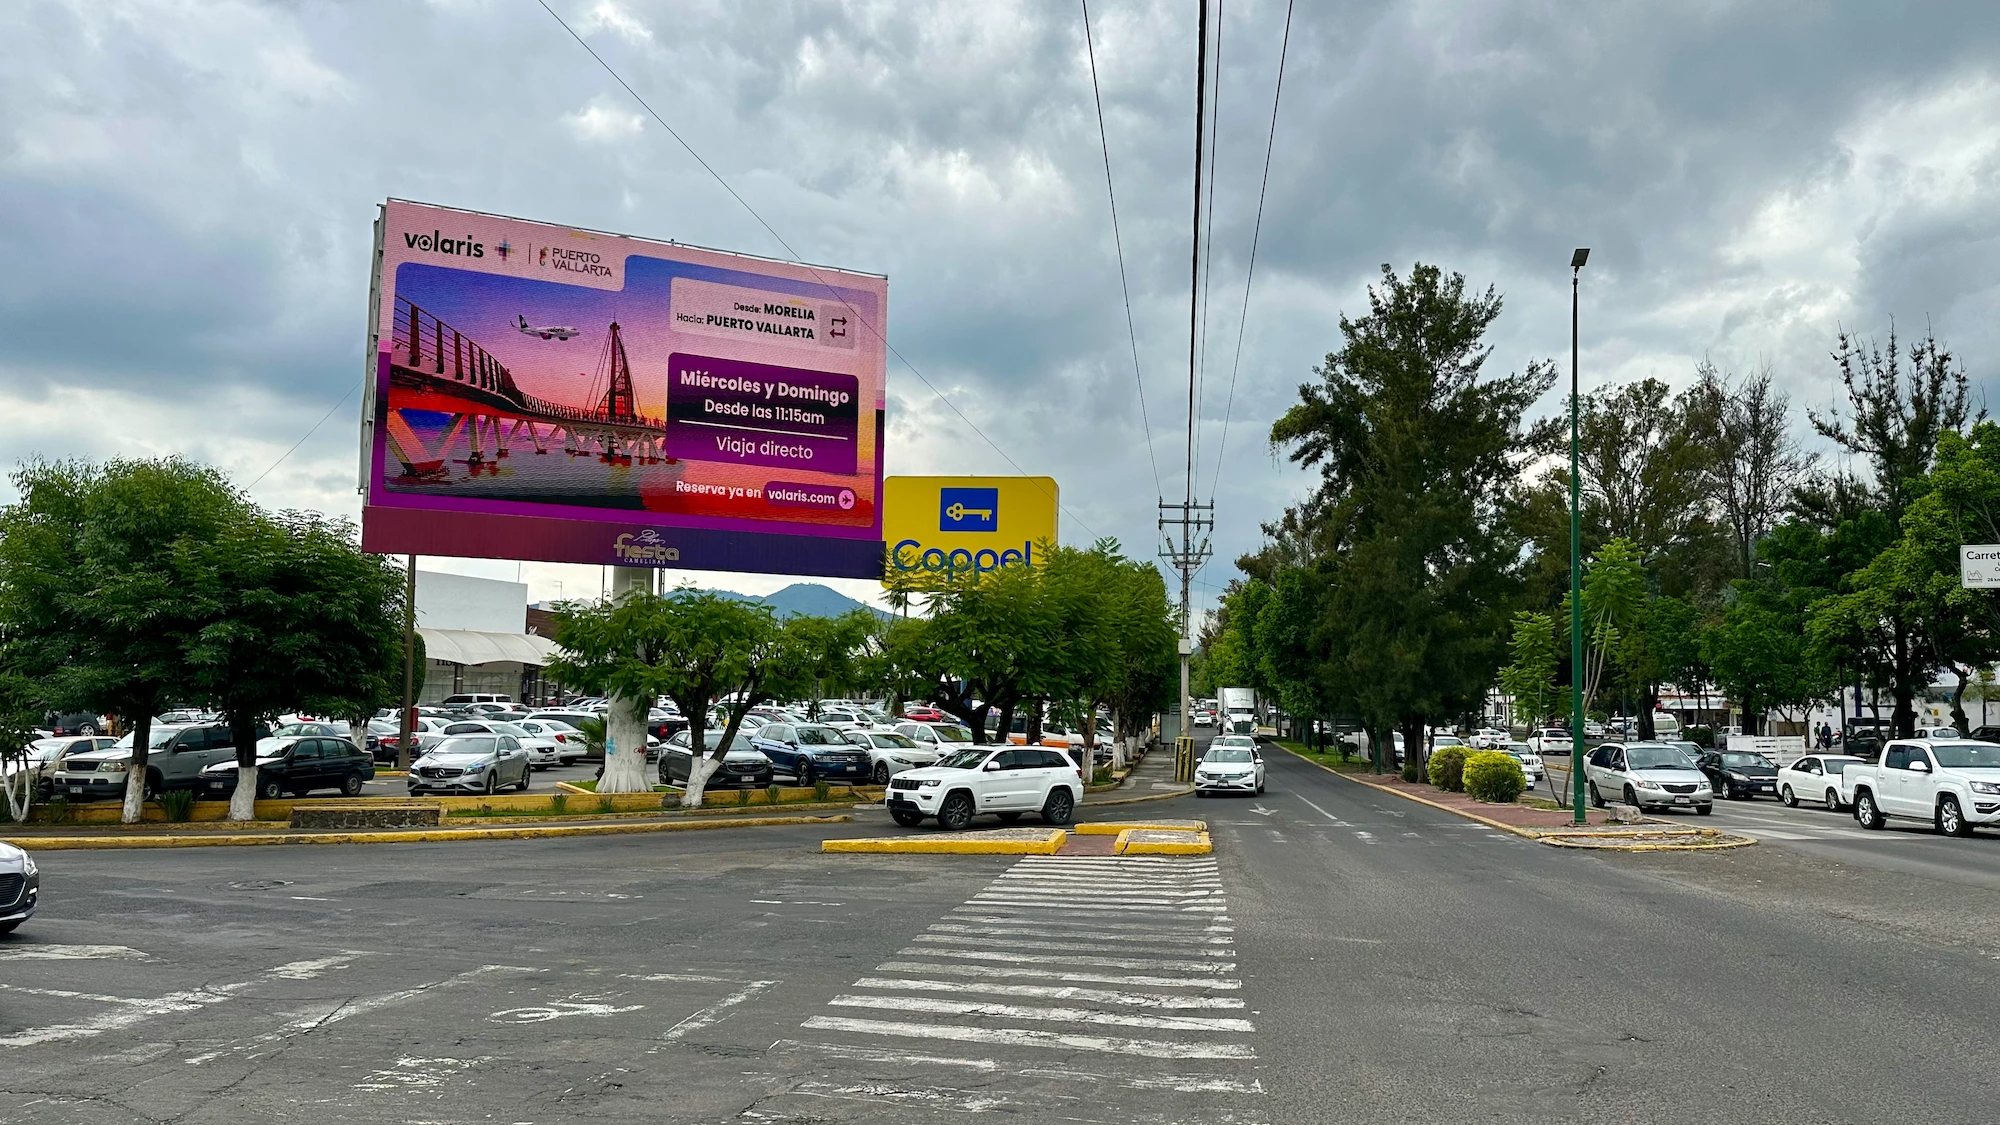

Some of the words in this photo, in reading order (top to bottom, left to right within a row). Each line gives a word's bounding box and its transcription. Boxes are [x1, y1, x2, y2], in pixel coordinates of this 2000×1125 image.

[404, 230, 484, 258] volaris
[552, 248, 601, 264] PUERTO
[552, 258, 613, 277] VALLARTA
[733, 302, 762, 314] Desde:
[764, 303, 816, 321] MORELIA
[676, 312, 704, 325] Hacia:
[706, 314, 754, 332] PUERTO
[756, 321, 815, 340] VALLARTA
[680, 370, 761, 394] Miércoles
[764, 383, 775, 400] y
[778, 382, 850, 407] Domingo
[704, 399, 749, 416] Desde
[752, 404, 772, 419] las
[775, 406, 825, 425] 11:15am
[716, 436, 756, 458] Viaja
[760, 441, 814, 460] directo
[676, 480, 726, 496] Reserva
[728, 486, 744, 499] ya
[746, 486, 761, 499] en
[768, 488, 835, 505] volaris.com
[613, 533, 680, 561] fiesta
[892, 539, 1032, 583] Coppel
